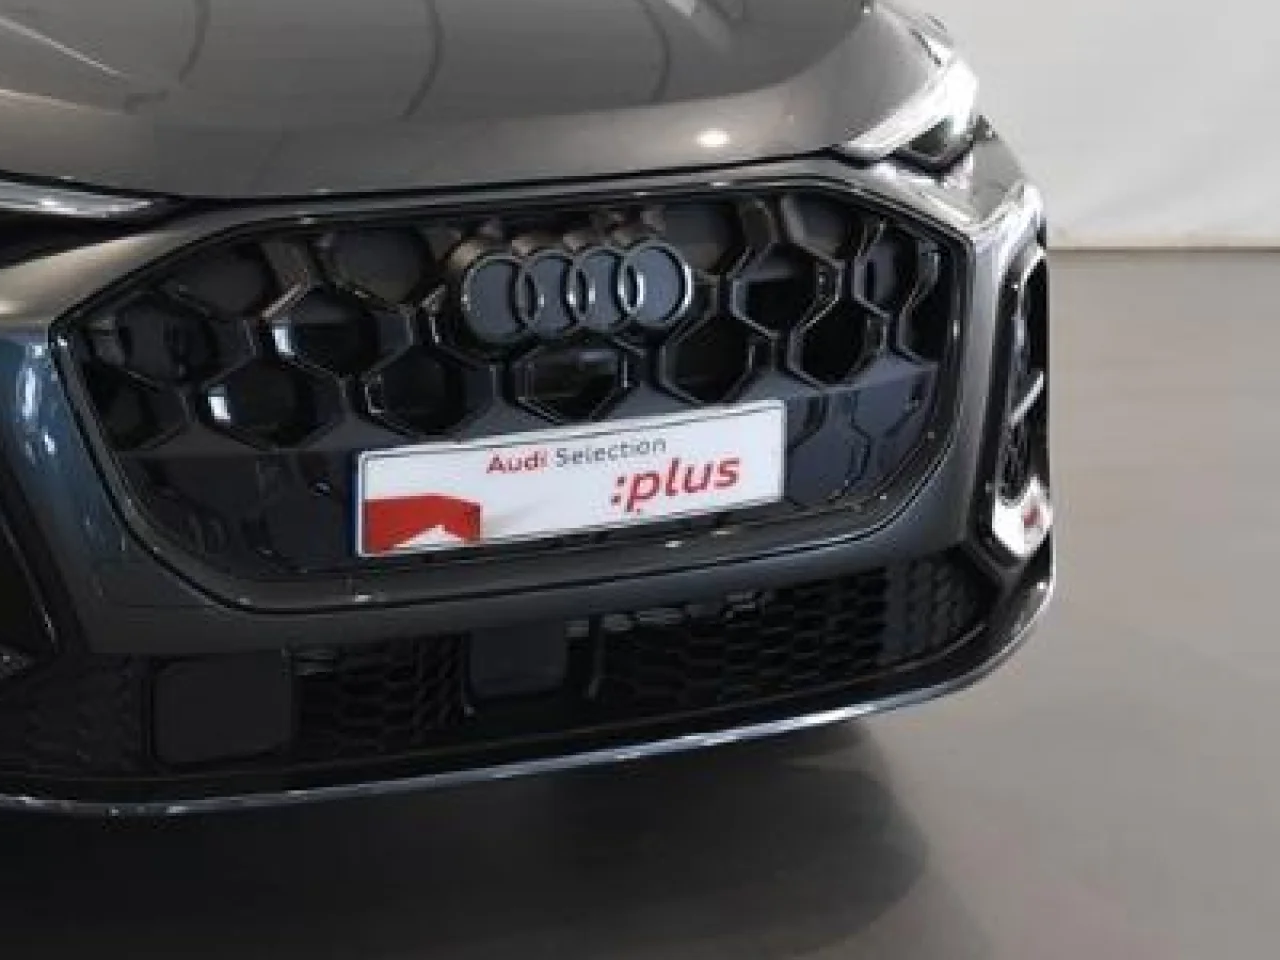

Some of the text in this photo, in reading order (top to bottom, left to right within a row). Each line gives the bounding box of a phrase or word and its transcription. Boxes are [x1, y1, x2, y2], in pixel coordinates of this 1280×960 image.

[486, 436, 668, 475] Audi Selection
[610, 455, 741, 513] :plus
